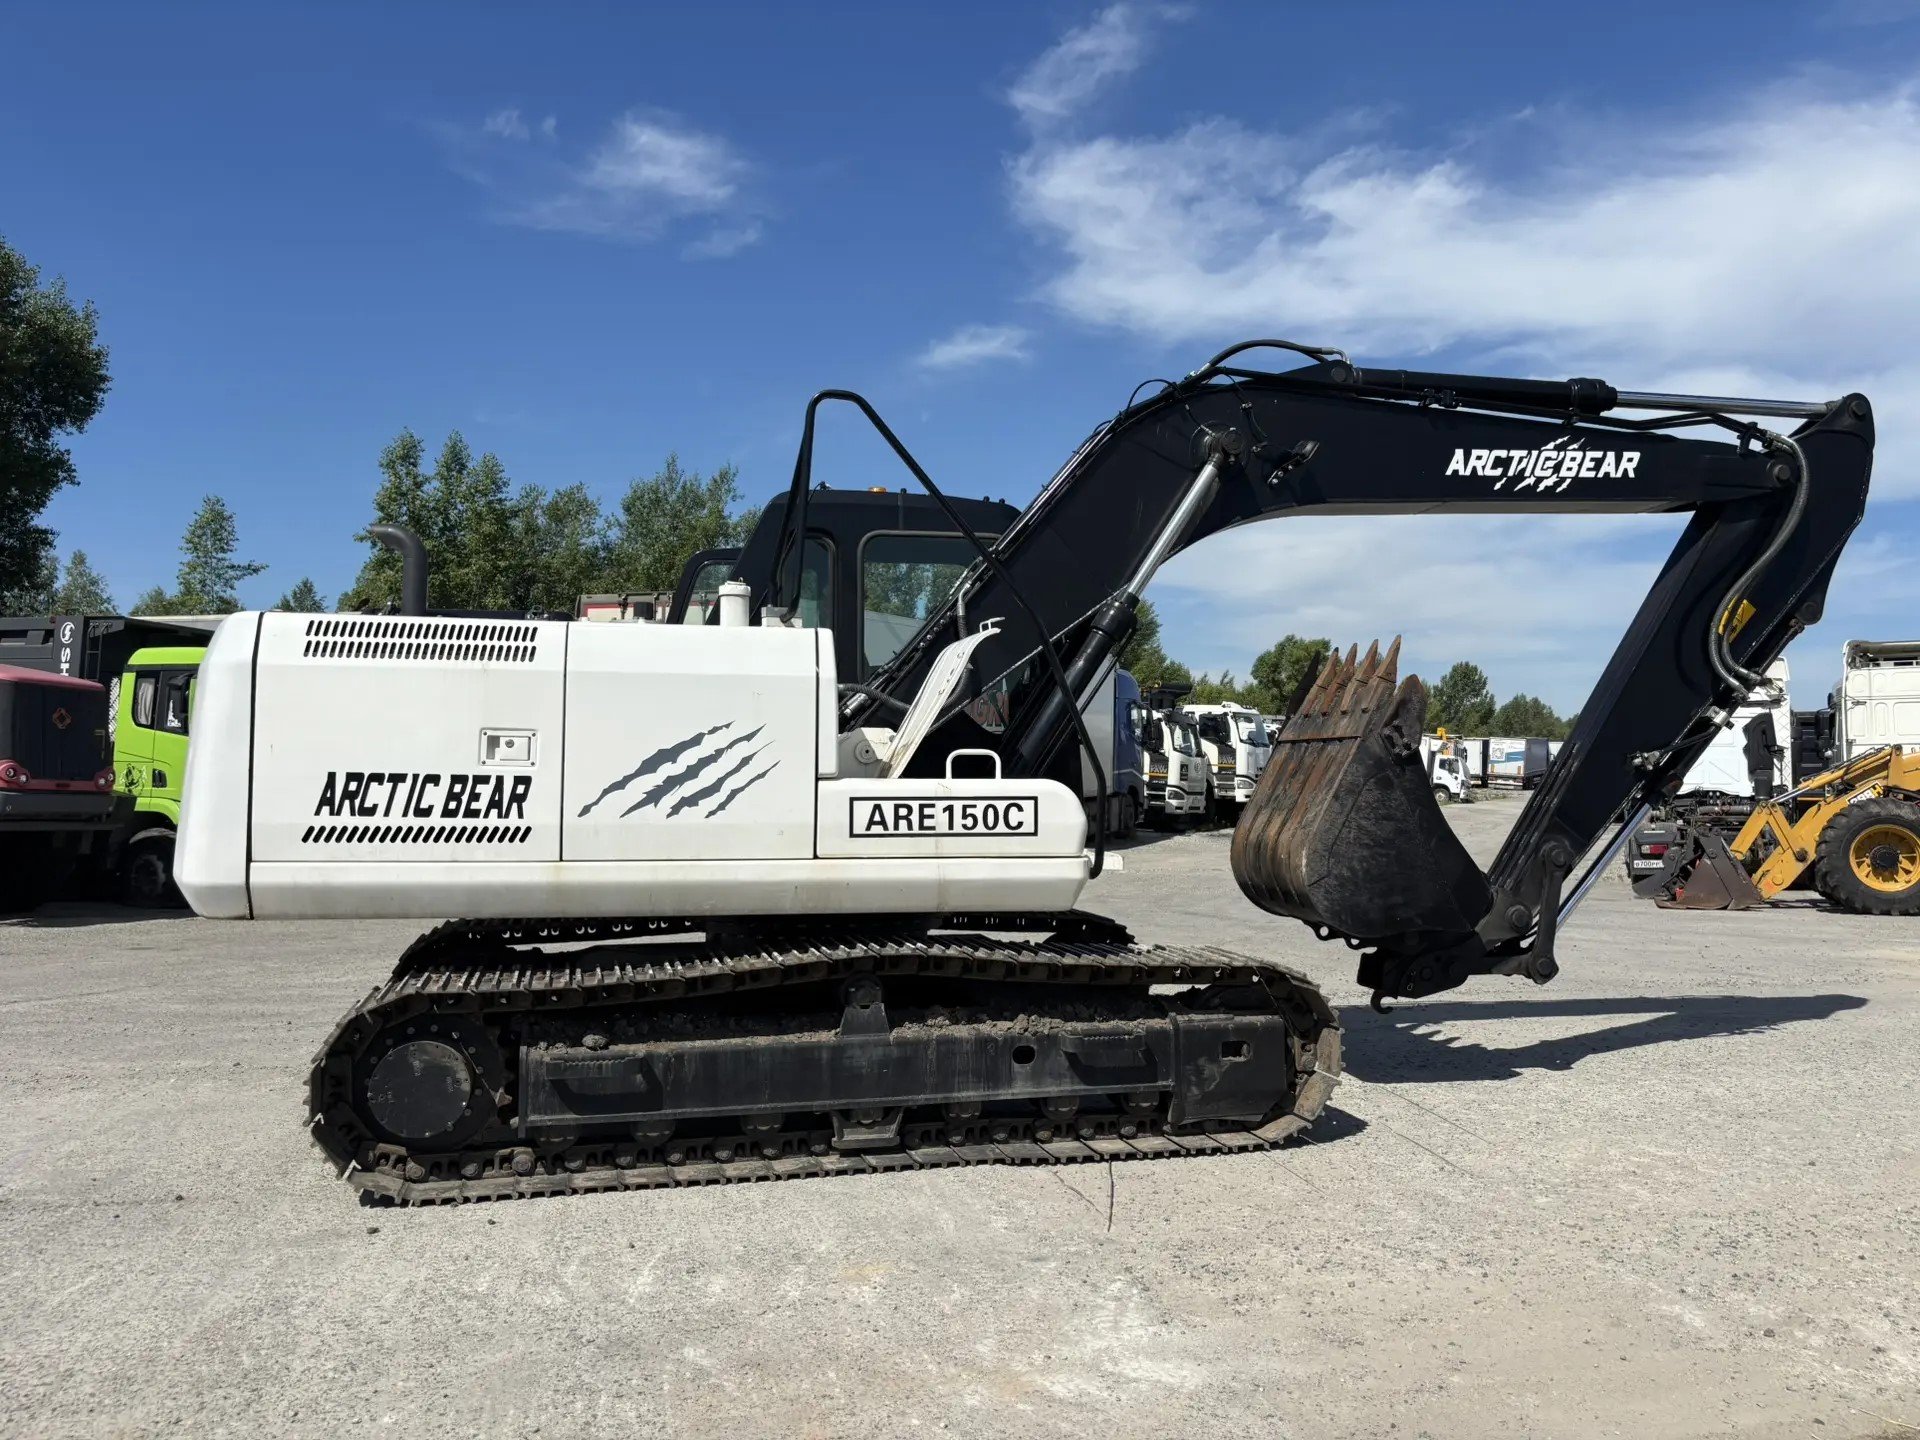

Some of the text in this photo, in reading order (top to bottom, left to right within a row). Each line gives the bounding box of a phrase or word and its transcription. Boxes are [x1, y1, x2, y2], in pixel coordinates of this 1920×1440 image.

[1445, 449, 1641, 478] ARCTIC BEAR
[314, 771, 533, 820] ARCTIC BEAR
[864, 802, 1024, 831] ARE150C
